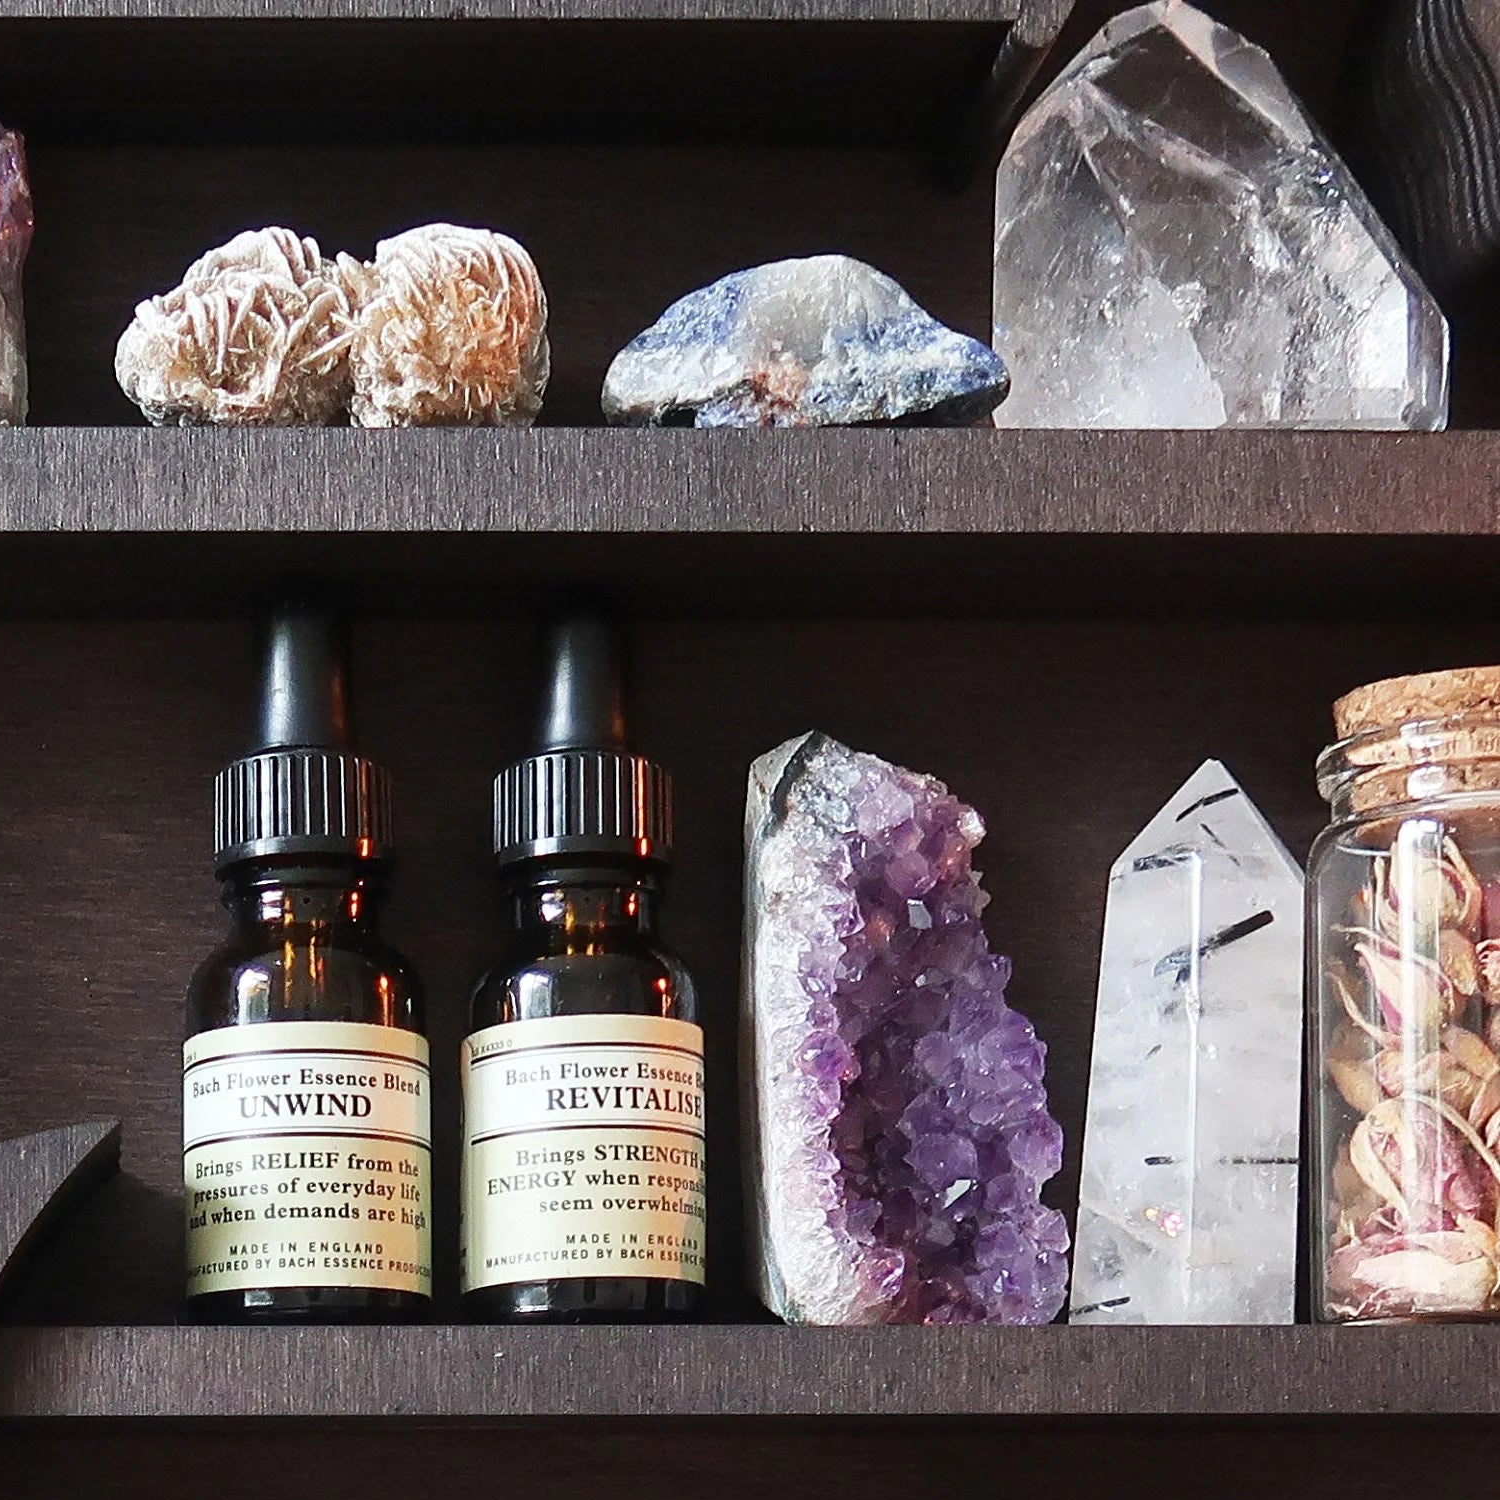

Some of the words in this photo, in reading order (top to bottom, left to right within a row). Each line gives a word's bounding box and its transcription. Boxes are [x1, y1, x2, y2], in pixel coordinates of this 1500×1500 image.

[193, 1076, 220, 1099] Bach
[227, 1070, 291, 1090] Flower
[300, 1068, 378, 1087] Essence
[383, 1072, 421, 1096] Blend
[505, 1065, 550, 1086] Bach
[560, 1062, 629, 1079] Flower
[637, 1062, 693, 1086] Essence
[239, 1093, 372, 1119] UNWIND
[546, 1085, 702, 1120] REVITALISE
[196, 1157, 243, 1180] Brings
[251, 1152, 340, 1171] RELIEF
[347, 1153, 393, 1173] from
[398, 1159, 419, 1177] the
[516, 1148, 585, 1167] Brings
[594, 1144, 698, 1169] STRENGTH
[194, 1182, 269, 1208] pressures
[277, 1177, 301, 1194] of
[306, 1180, 396, 1201] everyday
[401, 1182, 421, 1202] life
[487, 1170, 577, 1197] ENERGY
[585, 1169, 640, 1186] when
[211, 1206, 256, 1224] when
[264, 1202, 360, 1219] demands
[367, 1207, 396, 1221] are
[401, 1207, 426, 1230] high
[539, 1197, 594, 1213] seem
[229, 1243, 269, 1257] MADE
[280, 1242, 297, 1253] IN
[309, 1241, 384, 1255] ENGLAND
[566, 1233, 611, 1245] MADE
[621, 1233, 638, 1244] IN
[647, 1234, 698, 1251] ENGLAND
[255, 1258, 271, 1269] BY
[278, 1256, 316, 1268] BACH
[324, 1257, 384, 1270] ESSENCE
[485, 1249, 589, 1269] MANUFACTURED
[596, 1248, 613, 1260] BY
[620, 1248, 654, 1260] BACH
[660, 1250, 697, 1266] ESSENCE
